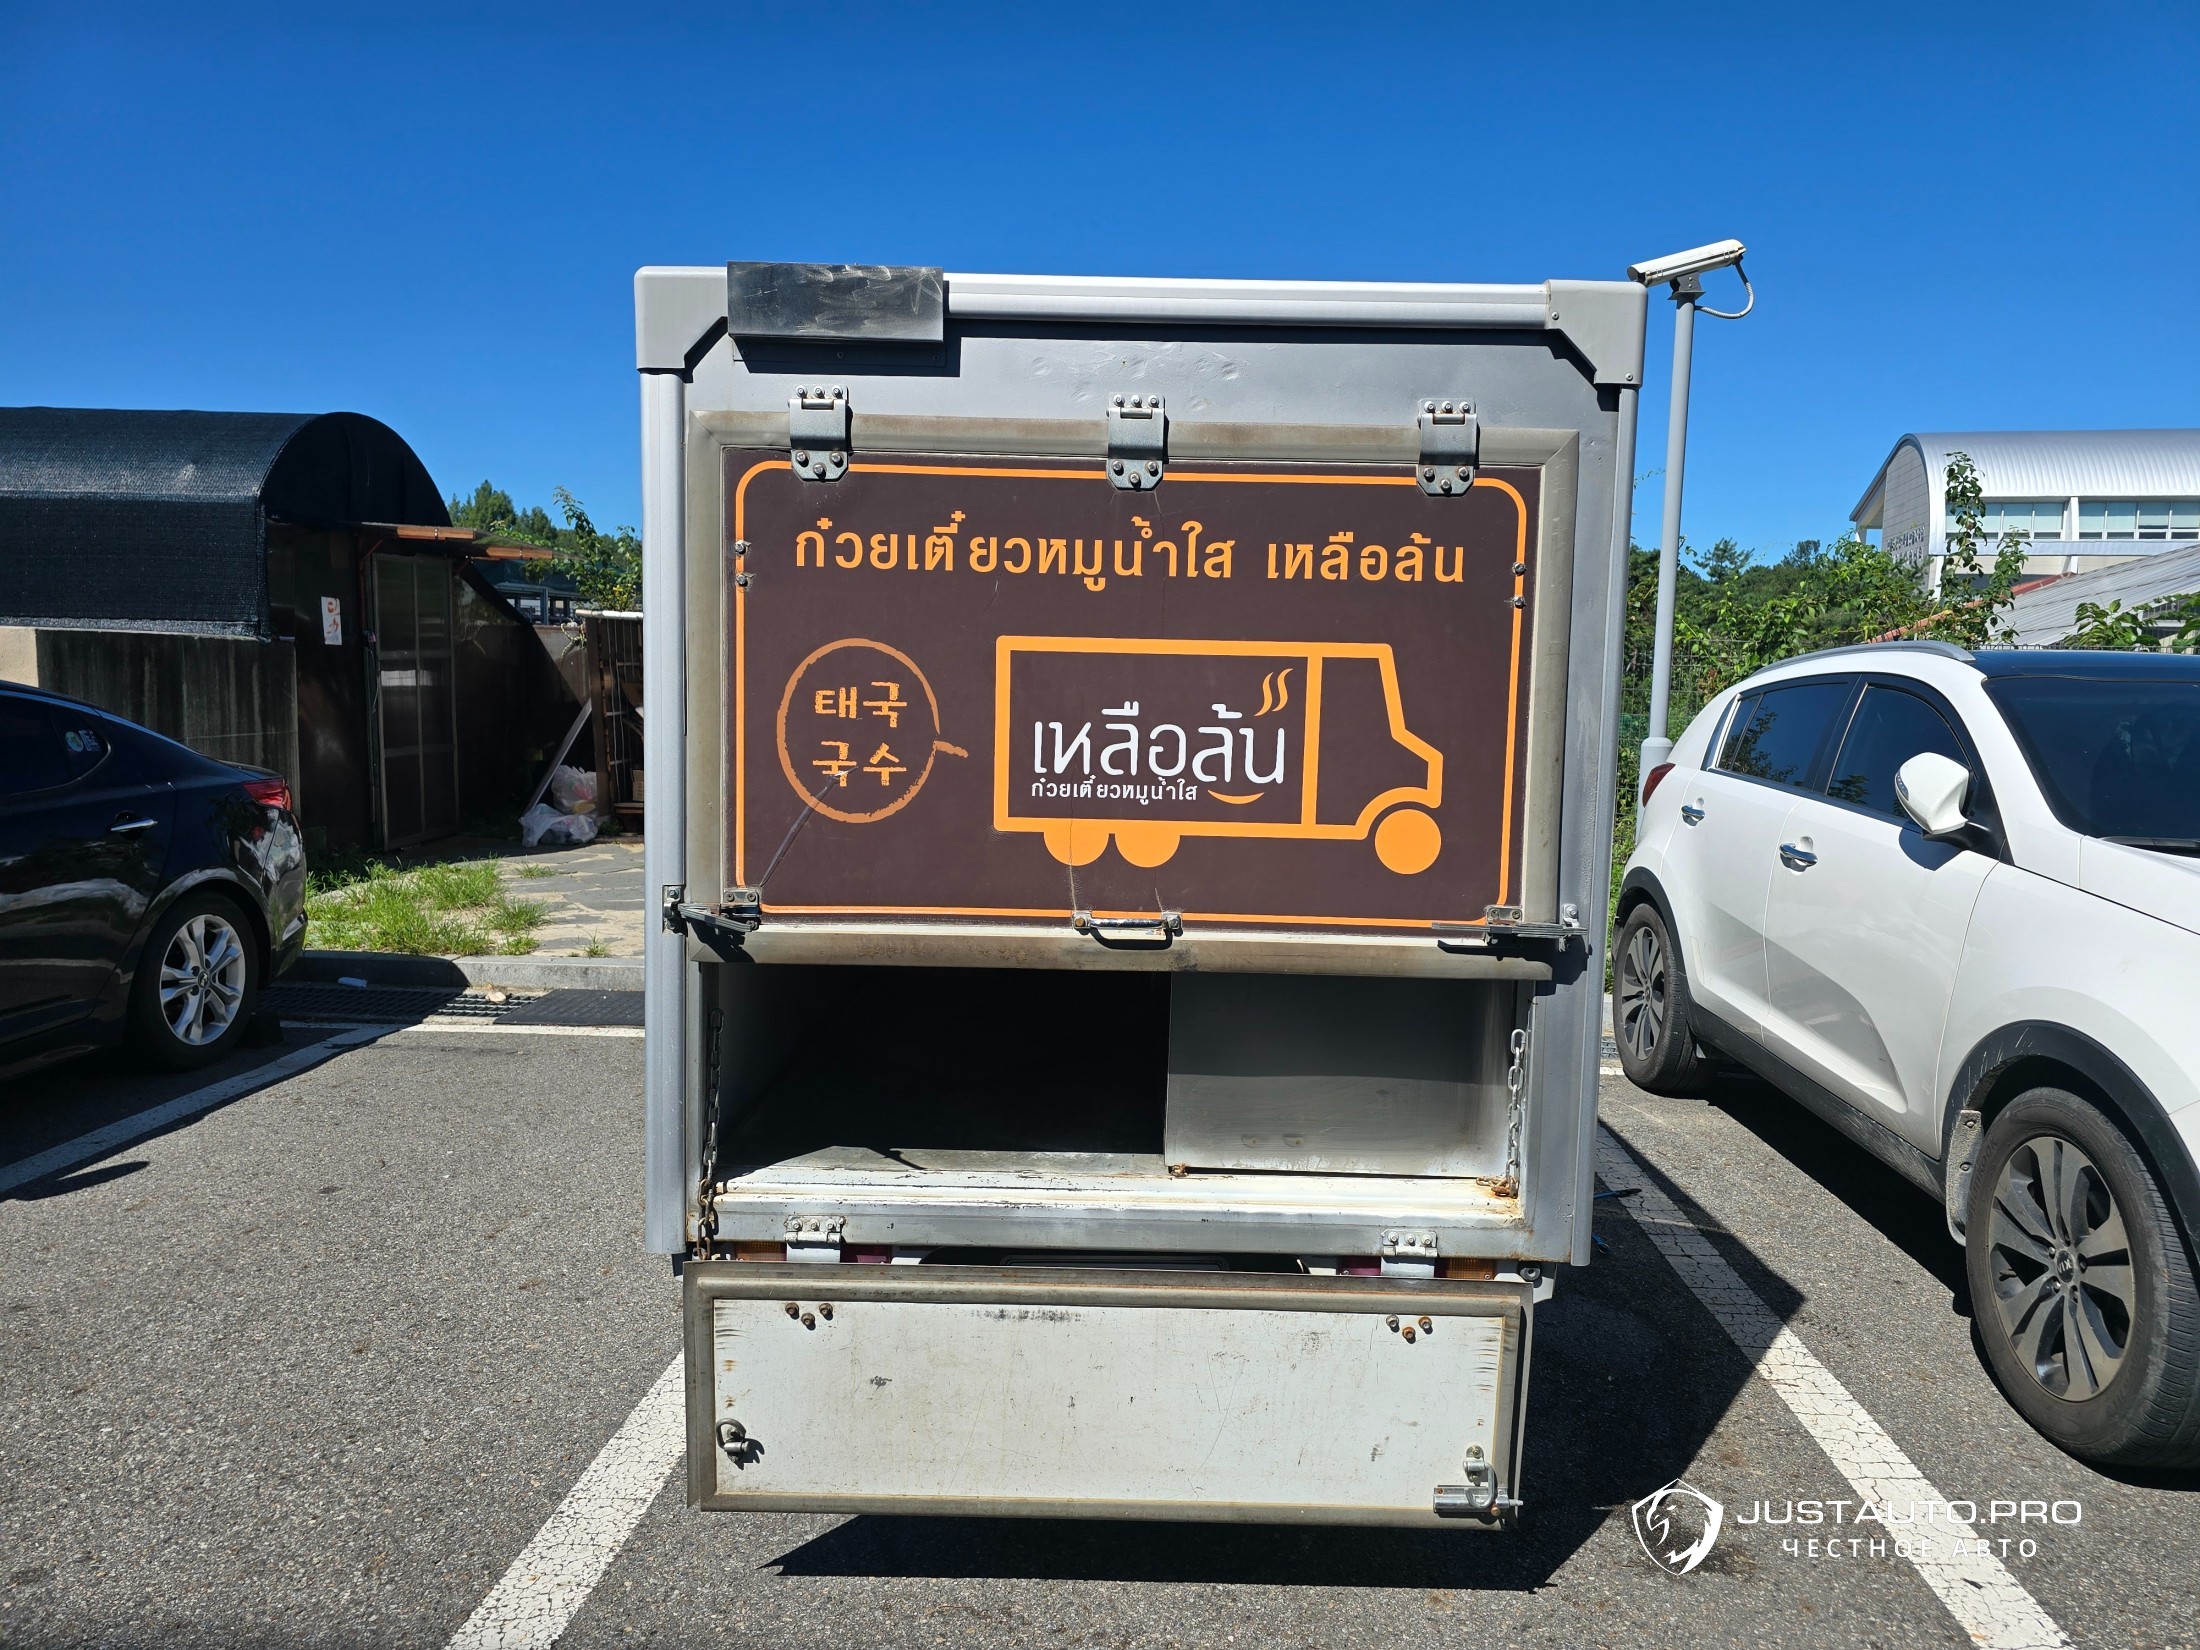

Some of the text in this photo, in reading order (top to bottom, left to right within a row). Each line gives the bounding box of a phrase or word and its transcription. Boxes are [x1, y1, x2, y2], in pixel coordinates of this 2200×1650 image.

[1267, 531, 1464, 583] เหลือล้น
[814, 681, 908, 728] 태국
[812, 741, 908, 788] 국수
[1034, 700, 1285, 784] เหลือล้น
